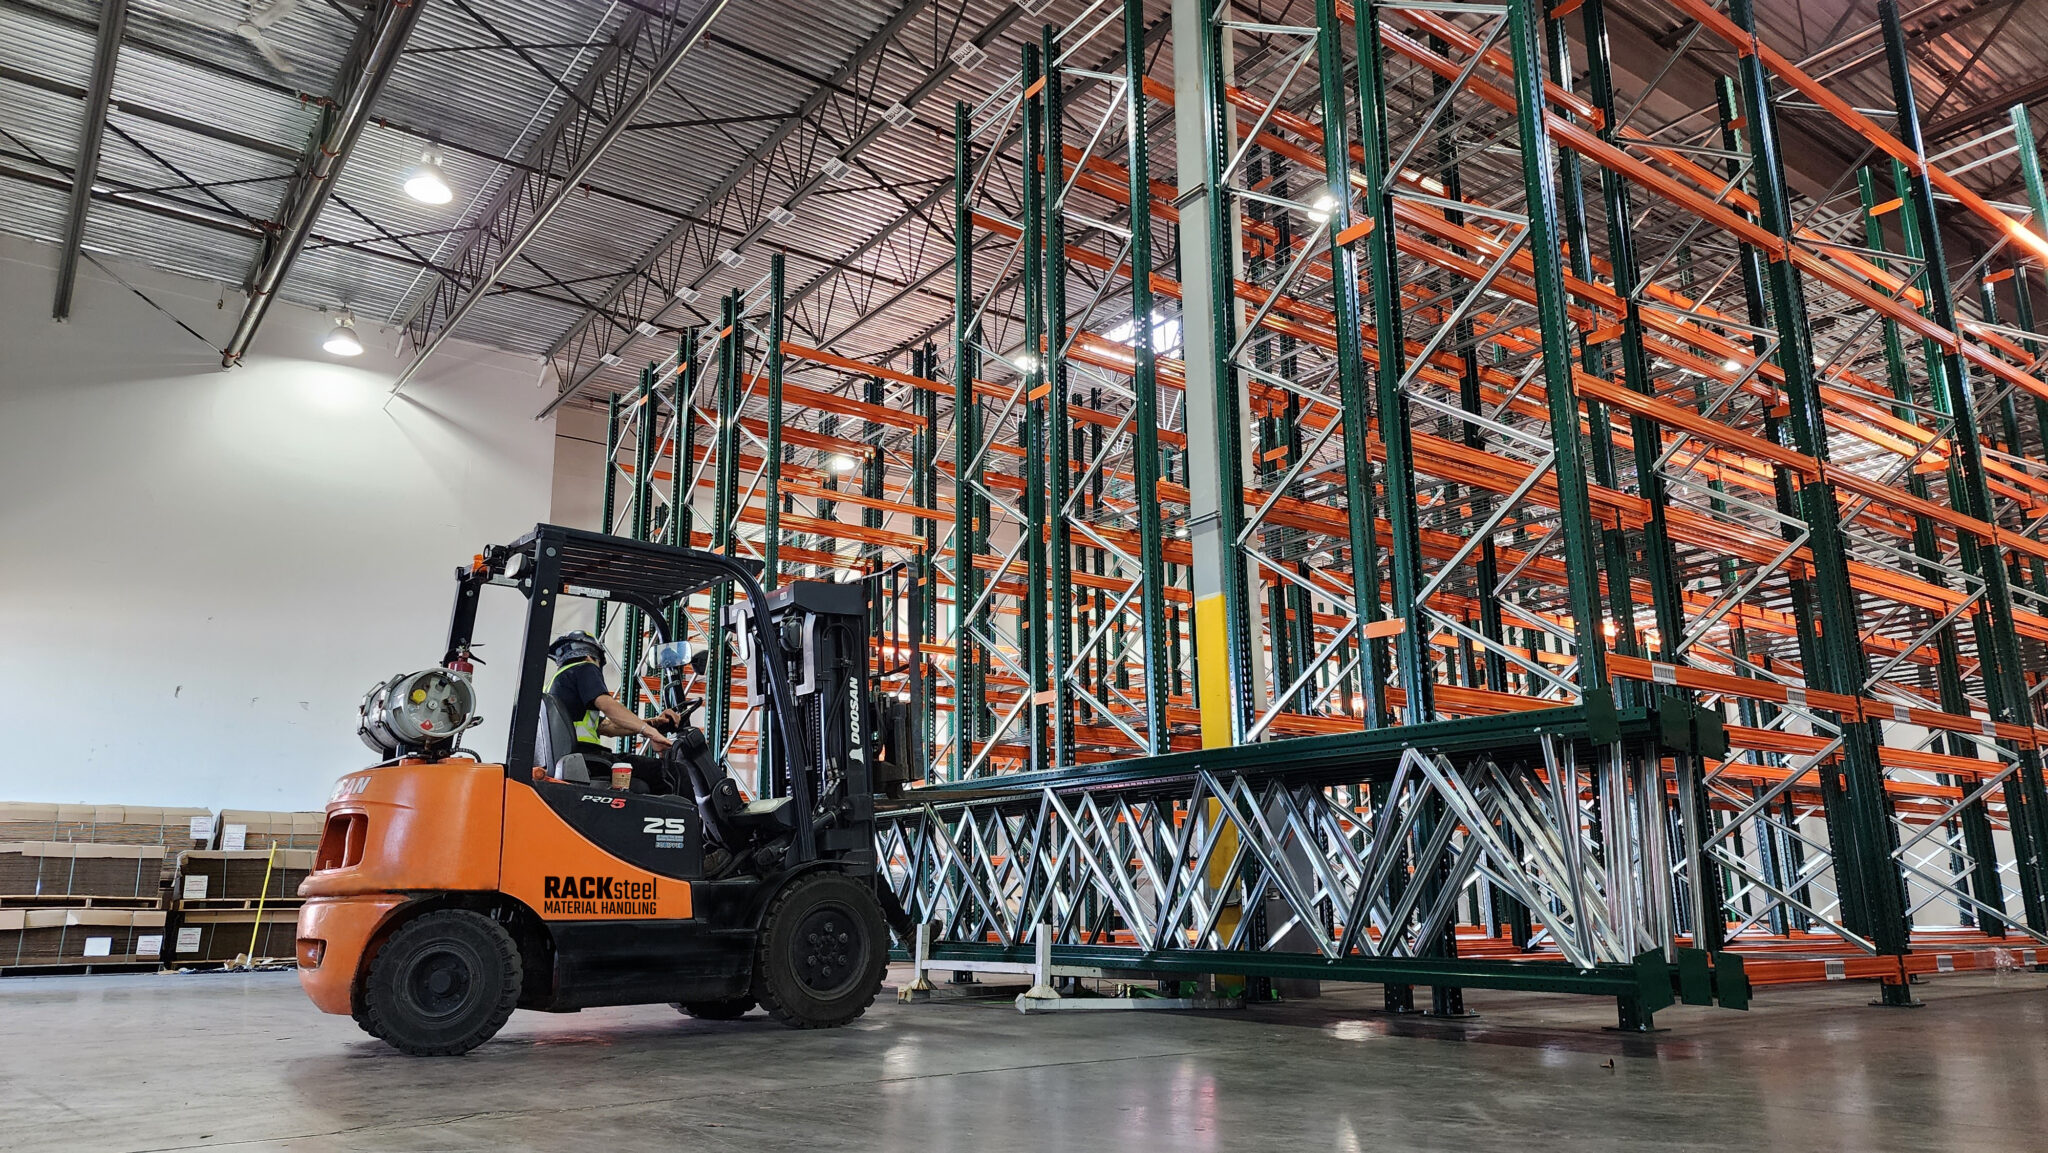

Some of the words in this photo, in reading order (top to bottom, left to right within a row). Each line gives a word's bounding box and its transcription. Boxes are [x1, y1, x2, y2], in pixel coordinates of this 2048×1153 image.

[849, 676, 860, 745] DOOSAN
[643, 817, 685, 834] 25
[544, 876, 657, 900] RACKsteel
[544, 900, 598, 914] MATERIAL
[601, 901, 657, 915] HANDLING
